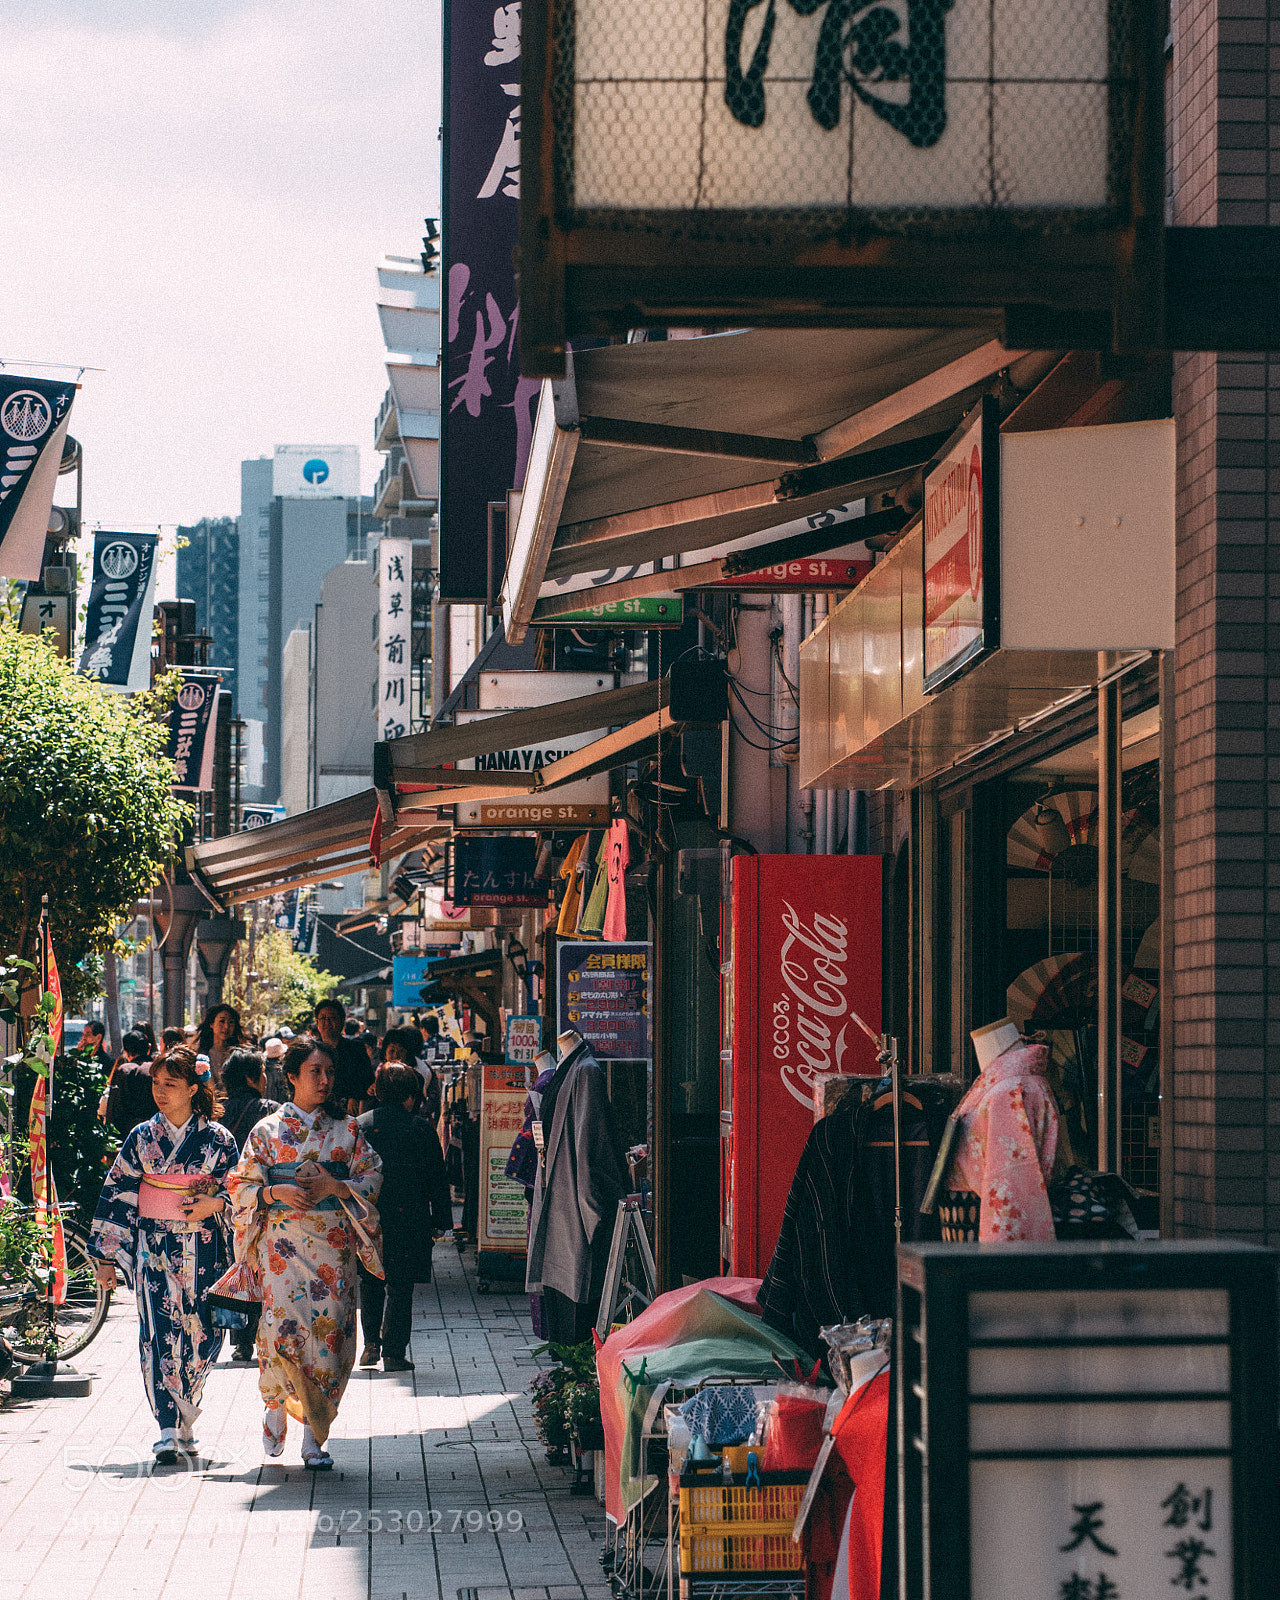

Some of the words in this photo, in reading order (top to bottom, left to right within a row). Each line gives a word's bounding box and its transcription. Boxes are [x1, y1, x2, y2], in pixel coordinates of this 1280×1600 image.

[808, 561, 833, 576] st.
[623, 599, 645, 613] st.
[475, 750, 576, 771] HANAYAS
[486, 807, 553, 821] orange
[558, 806, 578, 818] st.
[473, 894, 513, 904] orange
[780, 899, 848, 1112] Coca-Cola
[1161, 1482, 1216, 1600] 創業
